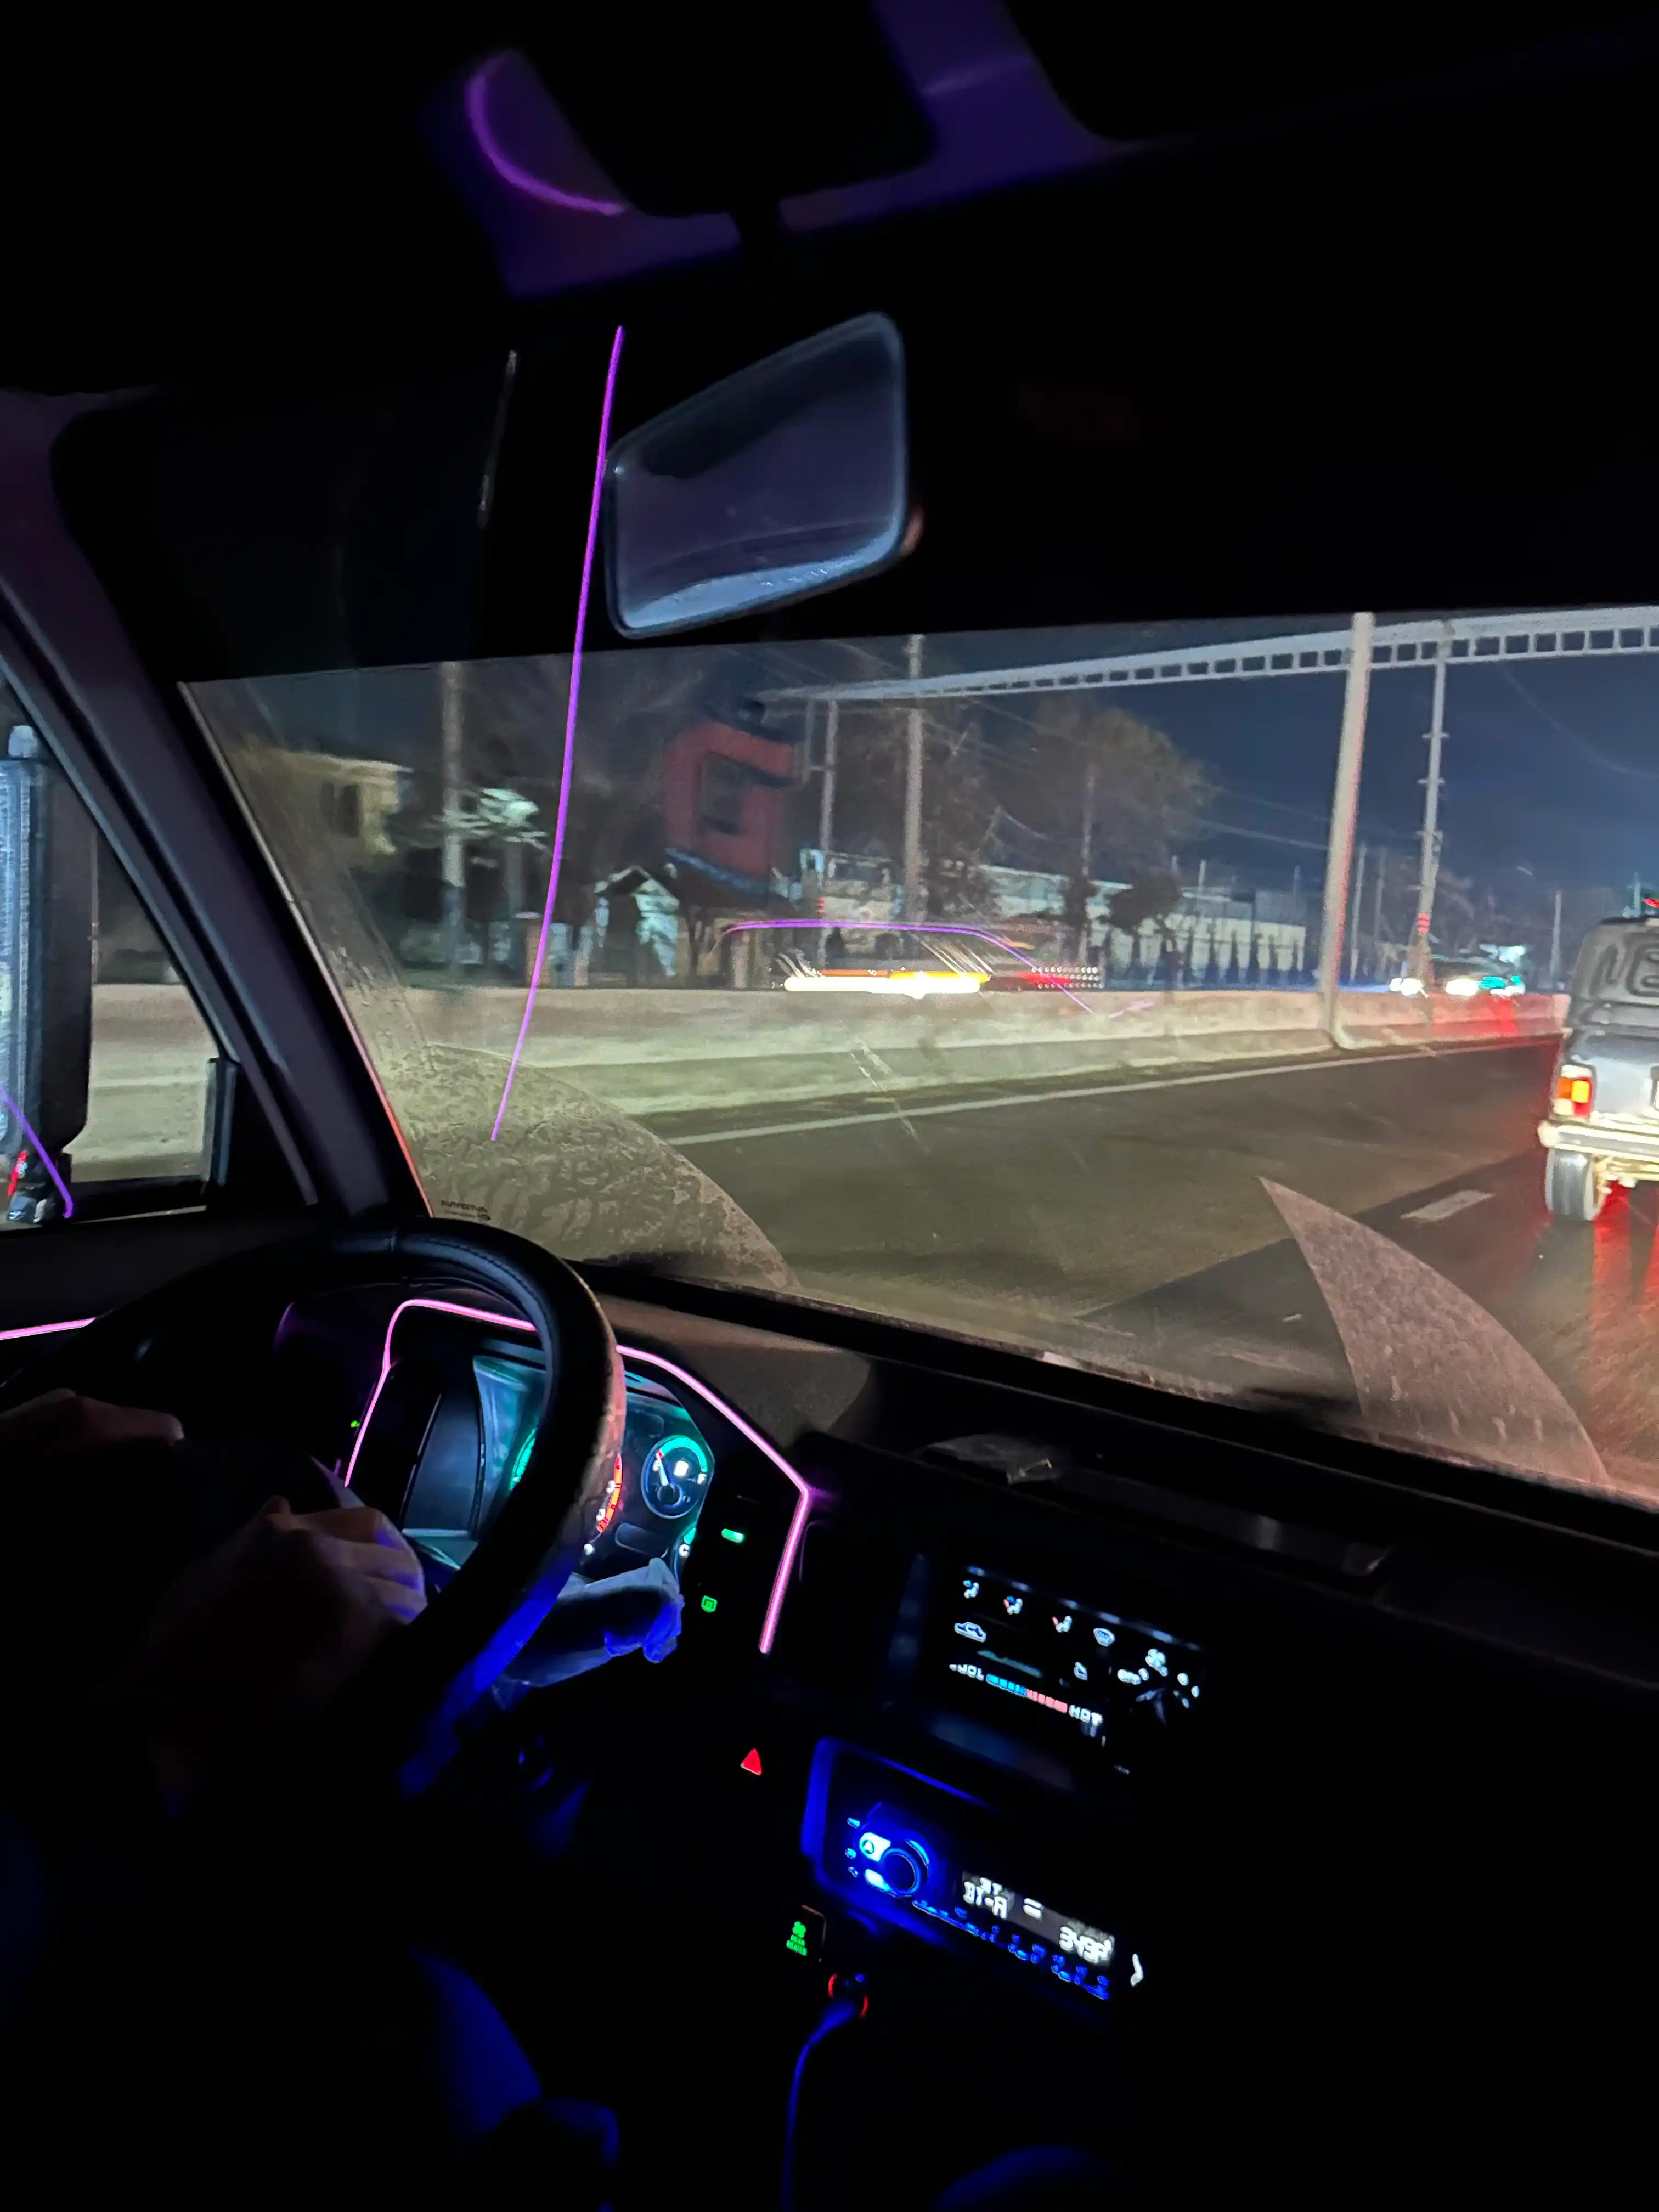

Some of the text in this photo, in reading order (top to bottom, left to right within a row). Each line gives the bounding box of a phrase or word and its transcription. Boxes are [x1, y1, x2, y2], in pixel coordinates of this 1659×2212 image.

[697, 1473, 706, 1484] F
[679, 1544, 690, 1557] C
[1069, 1705, 1103, 1726] HOT
